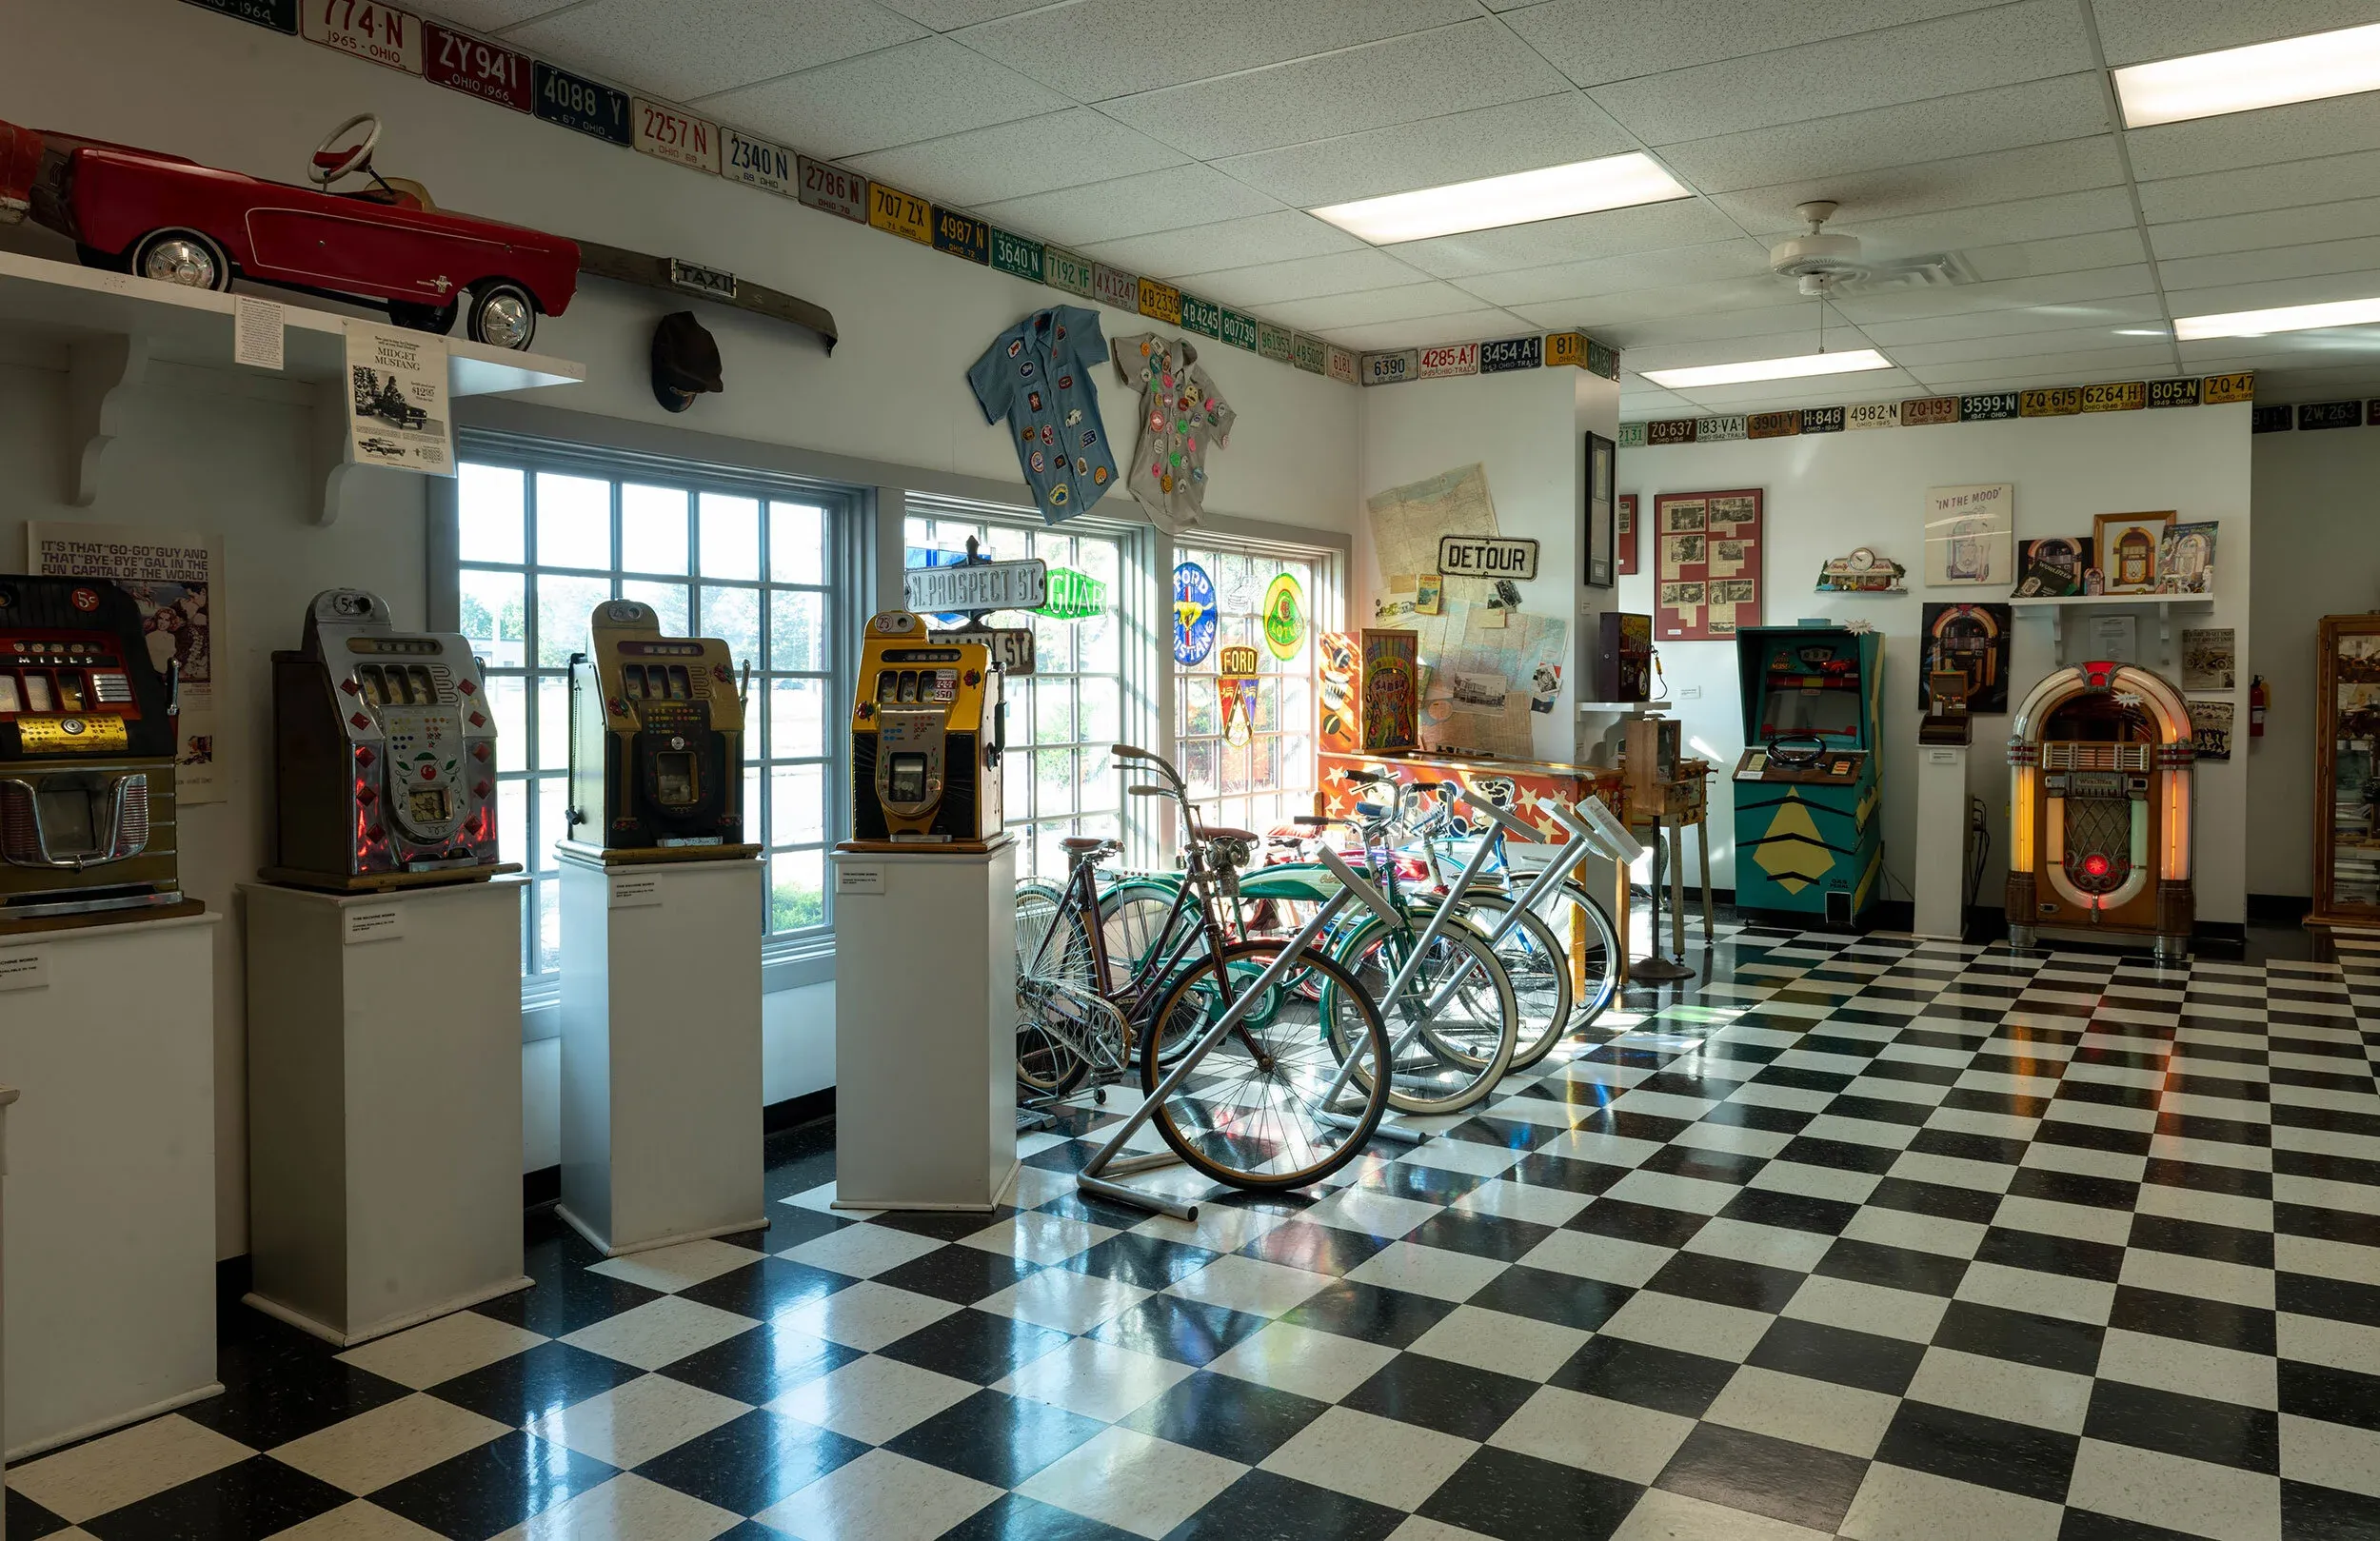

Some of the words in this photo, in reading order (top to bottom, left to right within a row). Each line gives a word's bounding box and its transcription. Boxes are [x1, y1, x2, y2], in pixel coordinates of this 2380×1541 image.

[239, 3, 271, 21] 1964
[327, 30, 357, 49] 1965
[369, 45, 401, 63] OHIO
[439, 31, 518, 89] ZY941
[452, 73, 480, 92] OHIO
[484, 80, 509, 102] 1966
[544, 74, 597, 116] 4088
[610, 96, 622, 125] Y
[562, 114, 576, 126] 67
[583, 120, 605, 136] OHIO
[644, 108, 687, 148] 2257
[694, 124, 707, 155] N
[659, 145, 680, 159] OHIO
[731, 138, 771, 175] 2340
[776, 152, 788, 181] N
[743, 172, 755, 183] 69
[760, 177, 779, 189] OHIO
[806, 166, 845, 199] 2786
[850, 180, 859, 205] N
[818, 198, 837, 210] OHIO
[877, 190, 902, 219] 707
[907, 201, 924, 227] ZX
[941, 215, 972, 243] 4987
[976, 227, 983, 249] N
[998, 240, 1028, 268] 3640
[1030, 250, 1039, 272] N
[679, 267, 732, 291] TAXI
[1049, 256, 1075, 284] 7192
[1224, 318, 1255, 343] 807739
[375, 355, 420, 370] MUSTANG
[378, 347, 416, 361] MIDGET
[1334, 354, 1351, 374] 6181
[1374, 358, 1405, 376] 6390
[1952, 495, 1968, 507] THE
[41, 541, 66, 552] IT'S
[68, 542, 103, 554] THAT
[155, 546, 182, 559] GUY
[183, 548, 208, 560] AND
[42, 552, 76, 563] THAT
[144, 557, 169, 568] GAL
[170, 558, 184, 569] IN
[188, 559, 208, 570] THE
[1448, 544, 1525, 571] DETOUR
[41, 563, 67, 575] FUN
[71, 564, 120, 577] CAPITAL
[123, 567, 138, 578] OF
[140, 567, 162, 579] THE
[167, 569, 208, 581] WORLD!
[1173, 569, 1209, 595] FORD
[912, 575, 925, 607] N.
[928, 570, 1009, 606] PROSPECT
[1016, 567, 1038, 601] ST.
[1045, 574, 1105, 615] GUAR
[1174, 621, 1215, 661] USTANG
[18, 656, 93, 664] MILLS
[1224, 650, 1255, 673] FORD
[936, 690, 952, 699] $50
[1376, 680, 1405, 692] SAMBA
